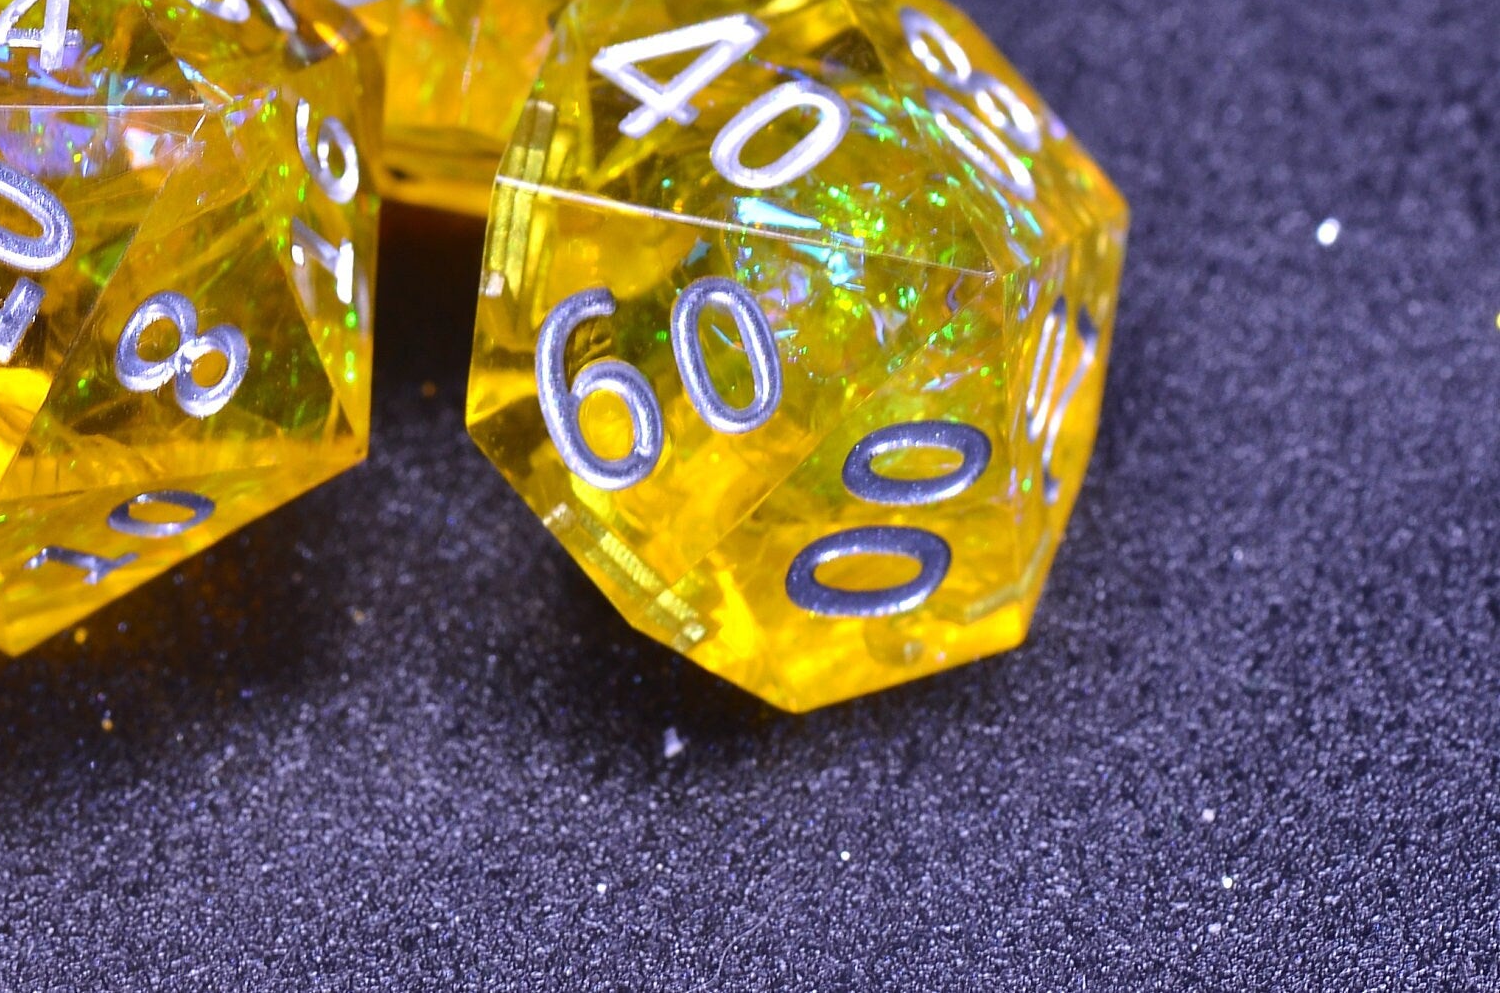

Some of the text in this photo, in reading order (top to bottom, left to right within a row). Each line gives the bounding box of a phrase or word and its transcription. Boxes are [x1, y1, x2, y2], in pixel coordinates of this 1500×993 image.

[592, 13, 850, 189] 40
[115, 290, 250, 418] 8
[536, 277, 784, 492] 60
